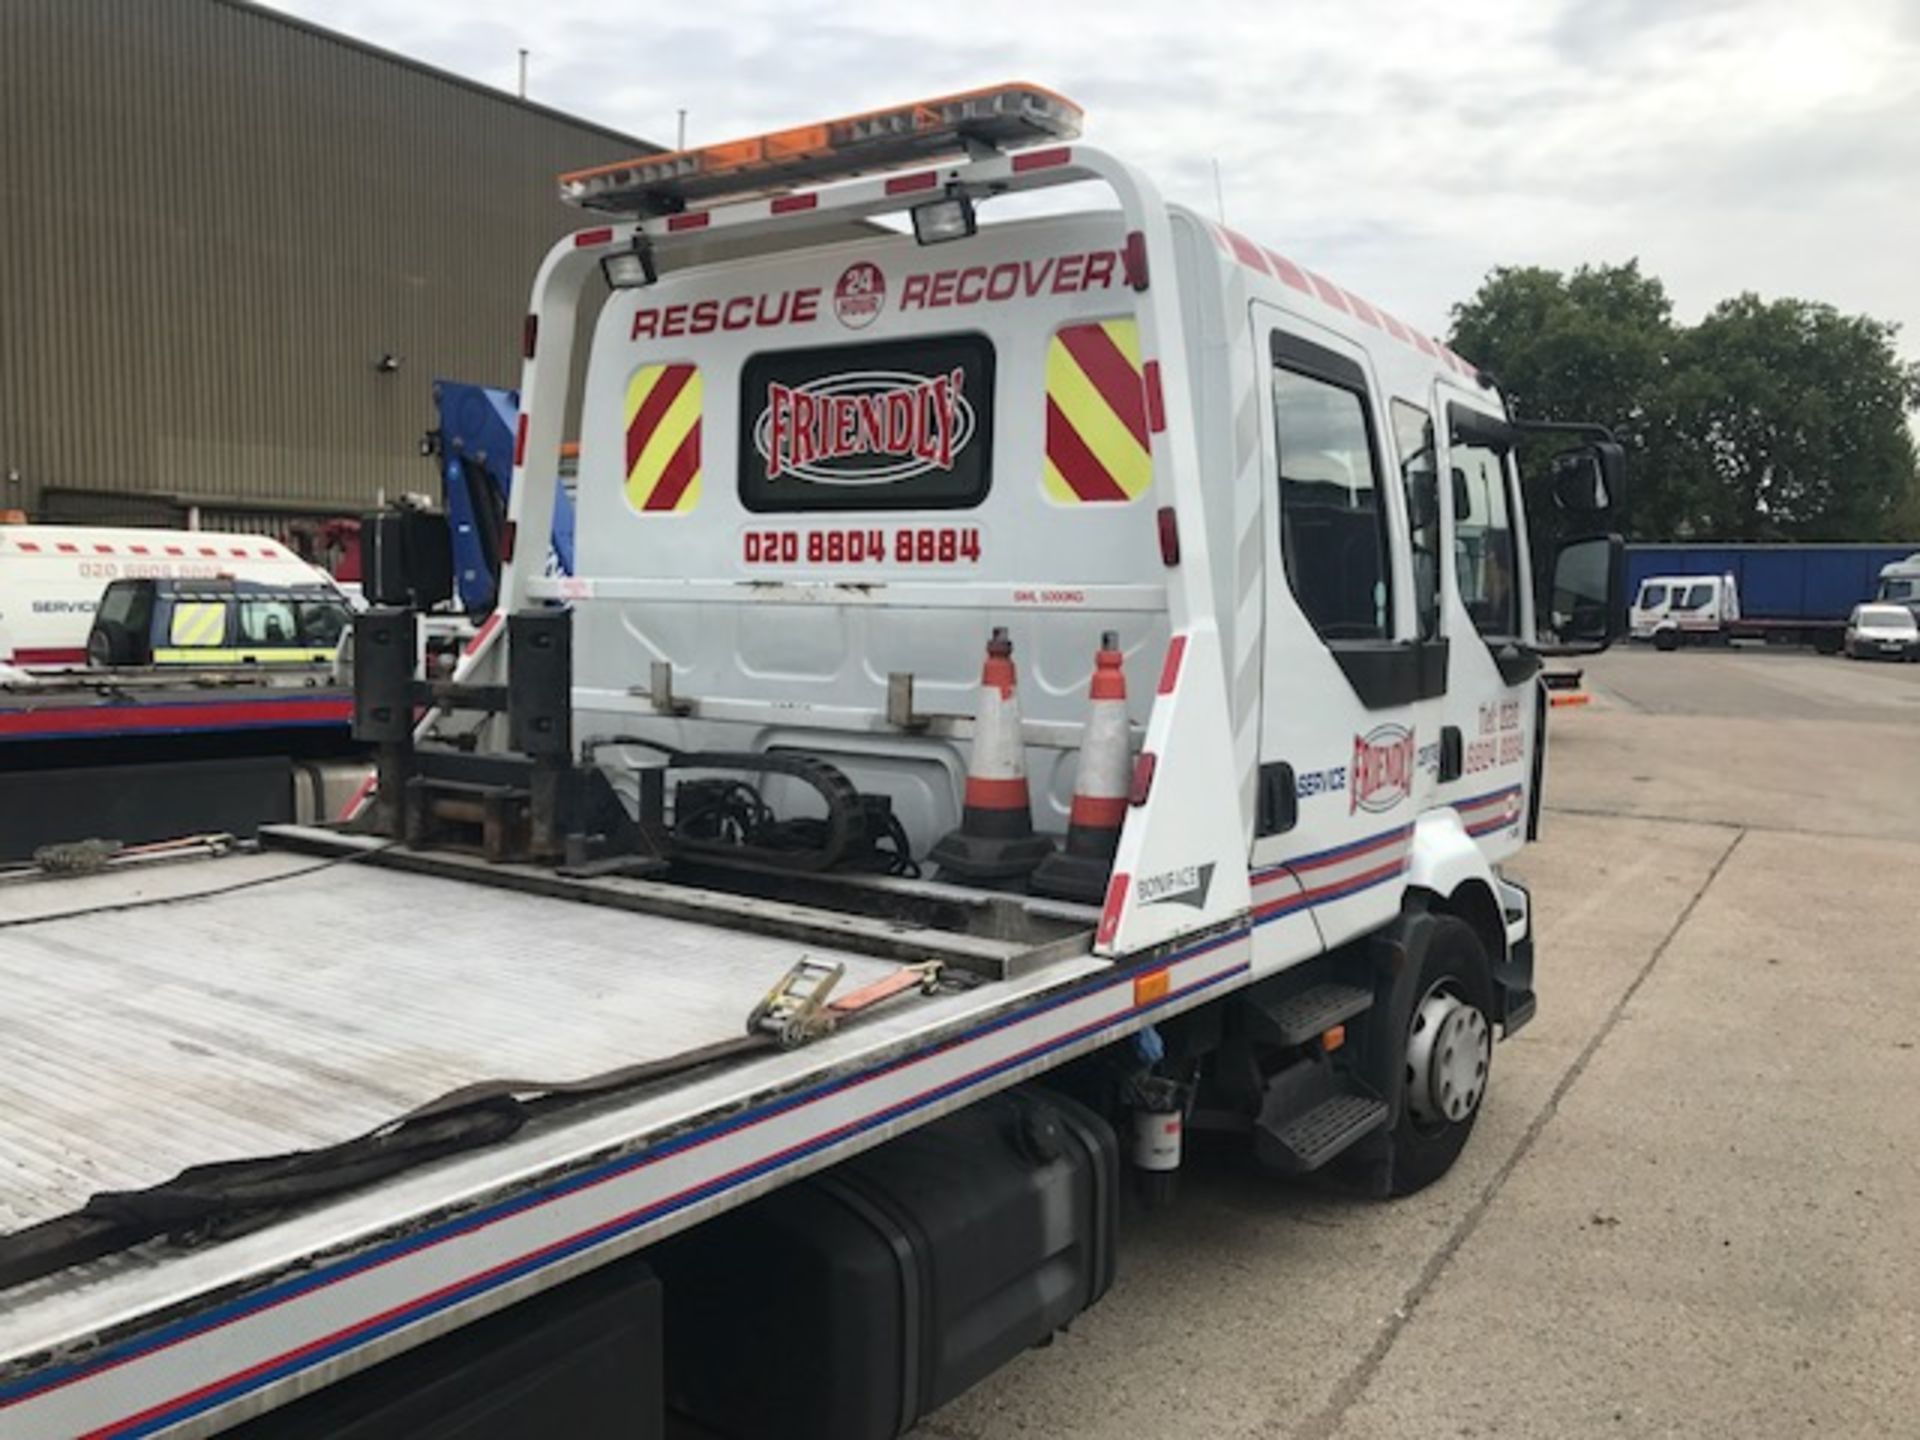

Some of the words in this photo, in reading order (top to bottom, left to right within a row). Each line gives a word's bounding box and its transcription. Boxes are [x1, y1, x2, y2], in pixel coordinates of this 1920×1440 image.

[844, 267, 874, 297] 24
[630, 287, 822, 341] RESCUE
[767, 367, 964, 480] FRIENDLY
[744, 531, 798, 563] 020
[807, 530, 885, 562] 8804
[895, 528, 981, 562] 8884
[1296, 766, 1346, 799] SERVICE
